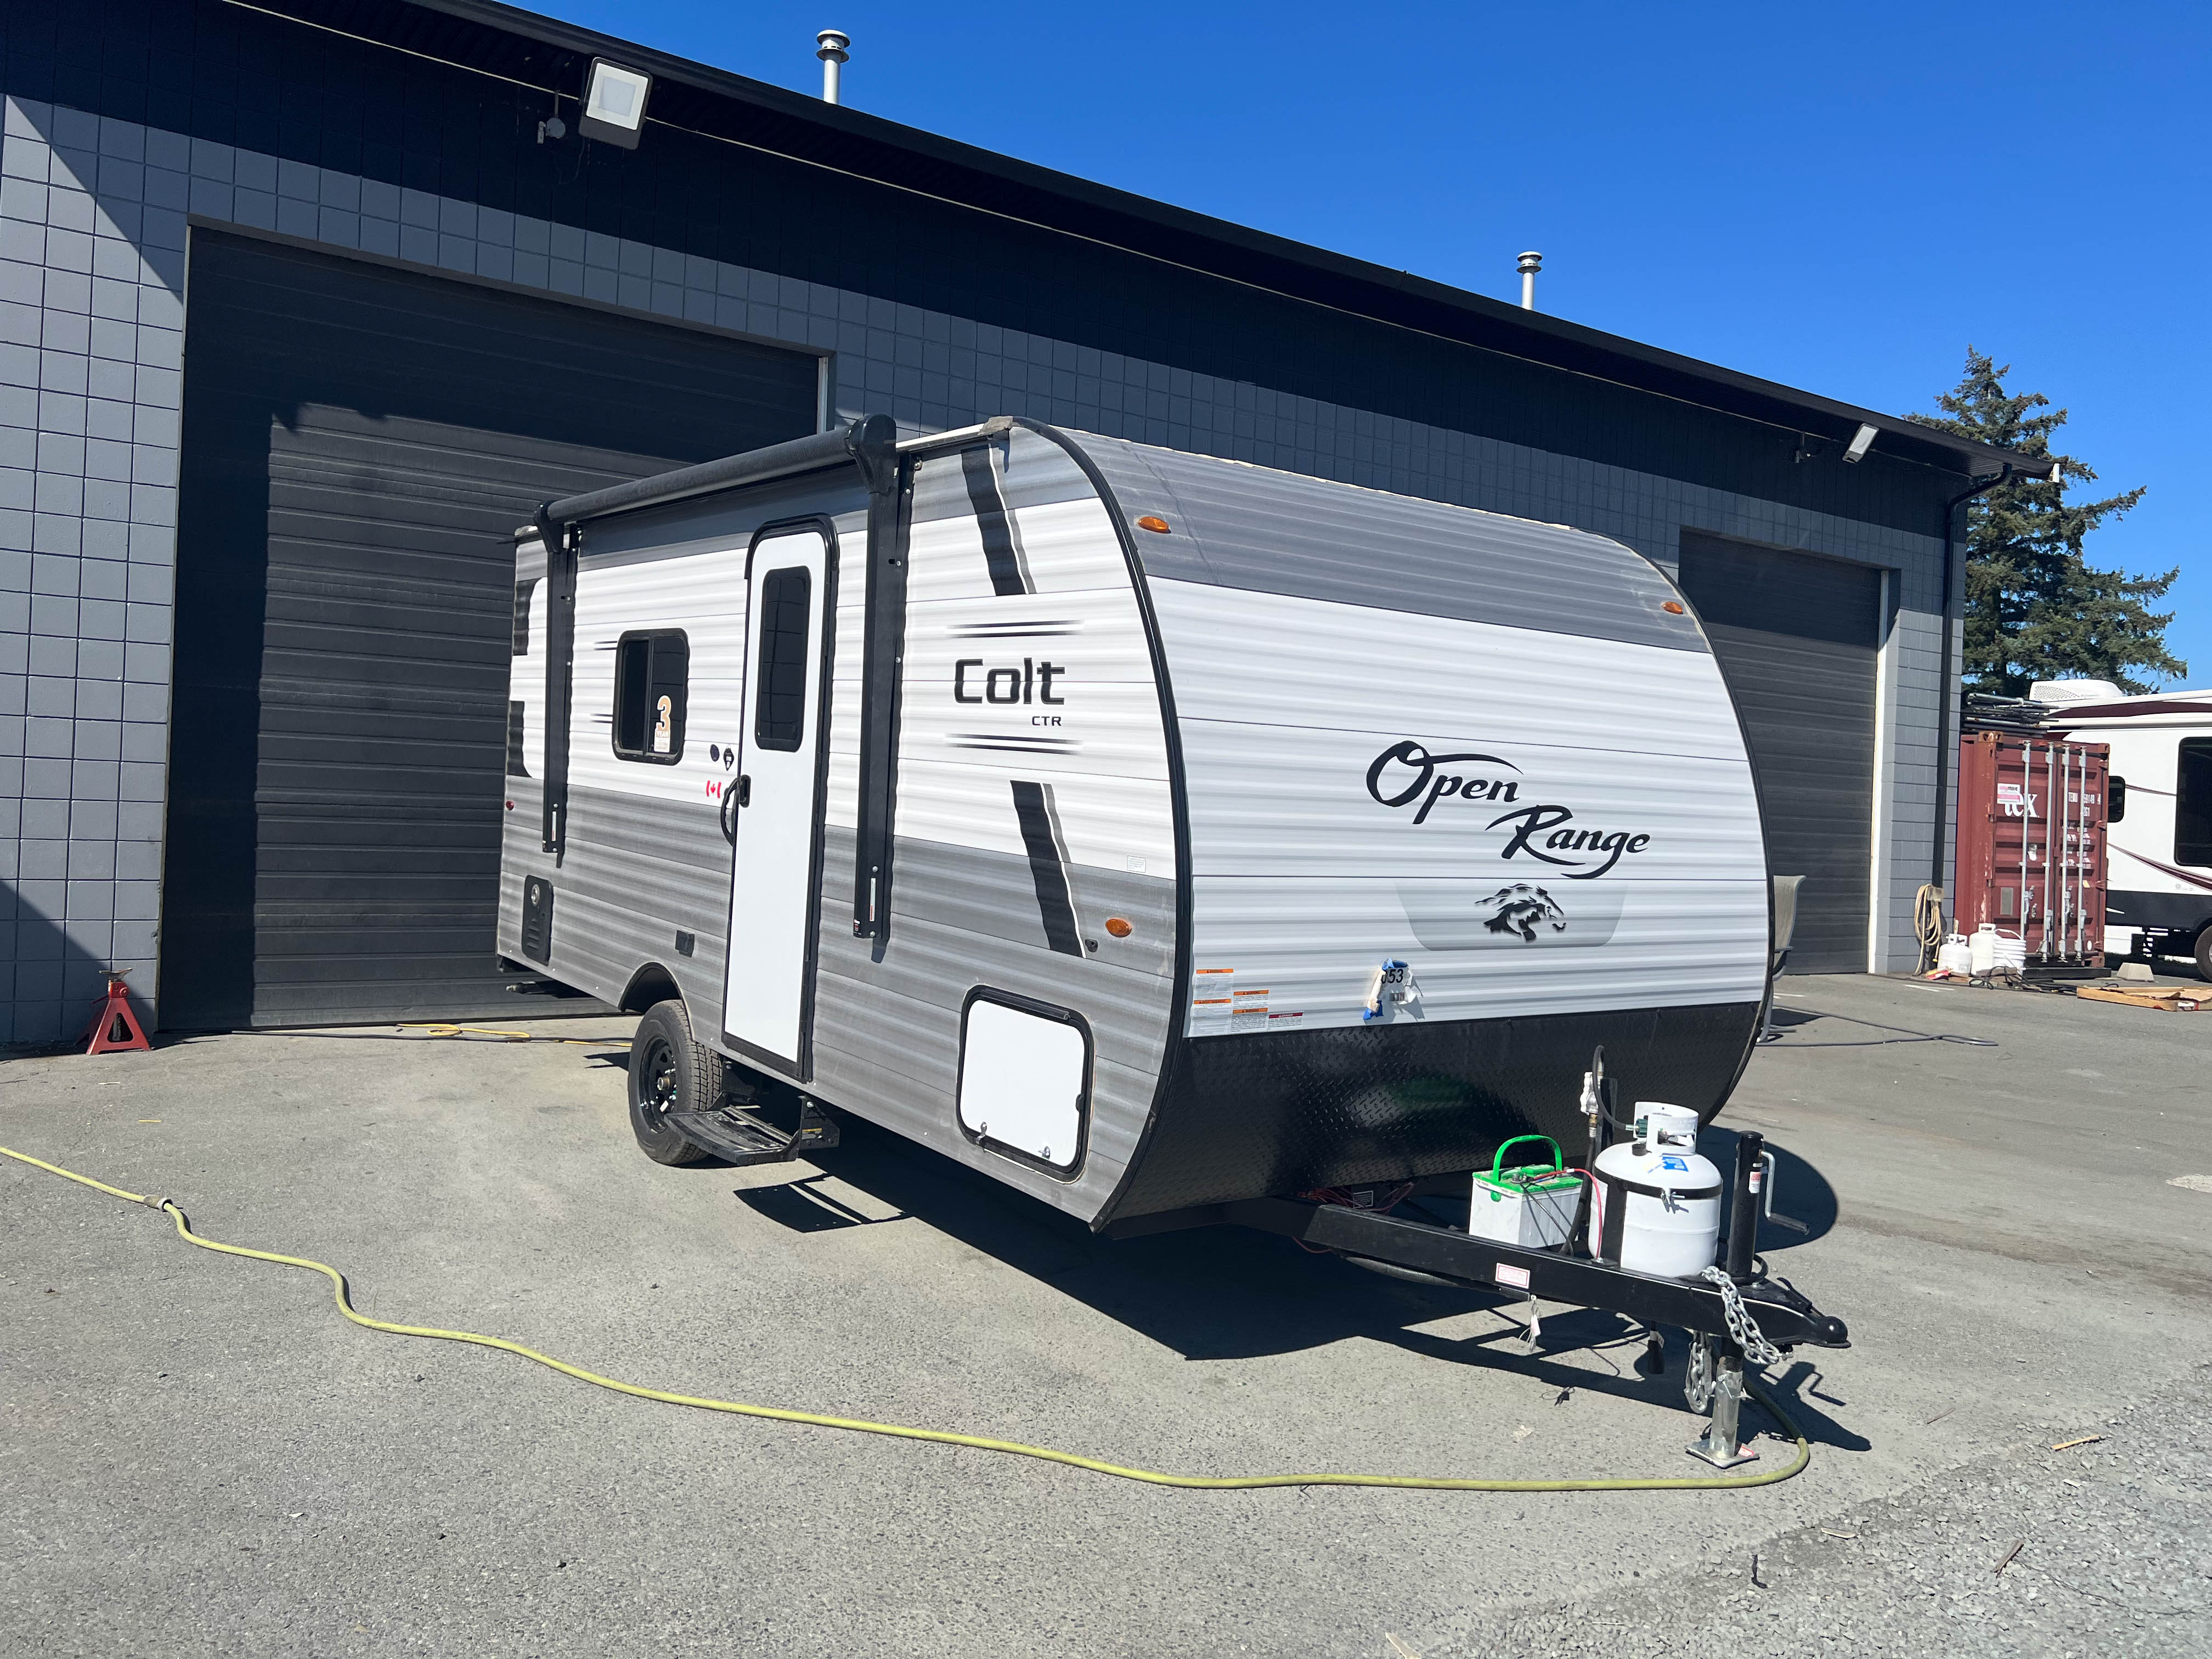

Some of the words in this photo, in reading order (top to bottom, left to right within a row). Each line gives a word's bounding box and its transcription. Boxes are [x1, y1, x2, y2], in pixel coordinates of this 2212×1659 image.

[954, 657, 1065, 705] Colt
[657, 696, 671, 731] 3
[1031, 716, 1062, 726] CTR
[1366, 740, 1523, 825] Open
[1485, 804, 1651, 879] Range
